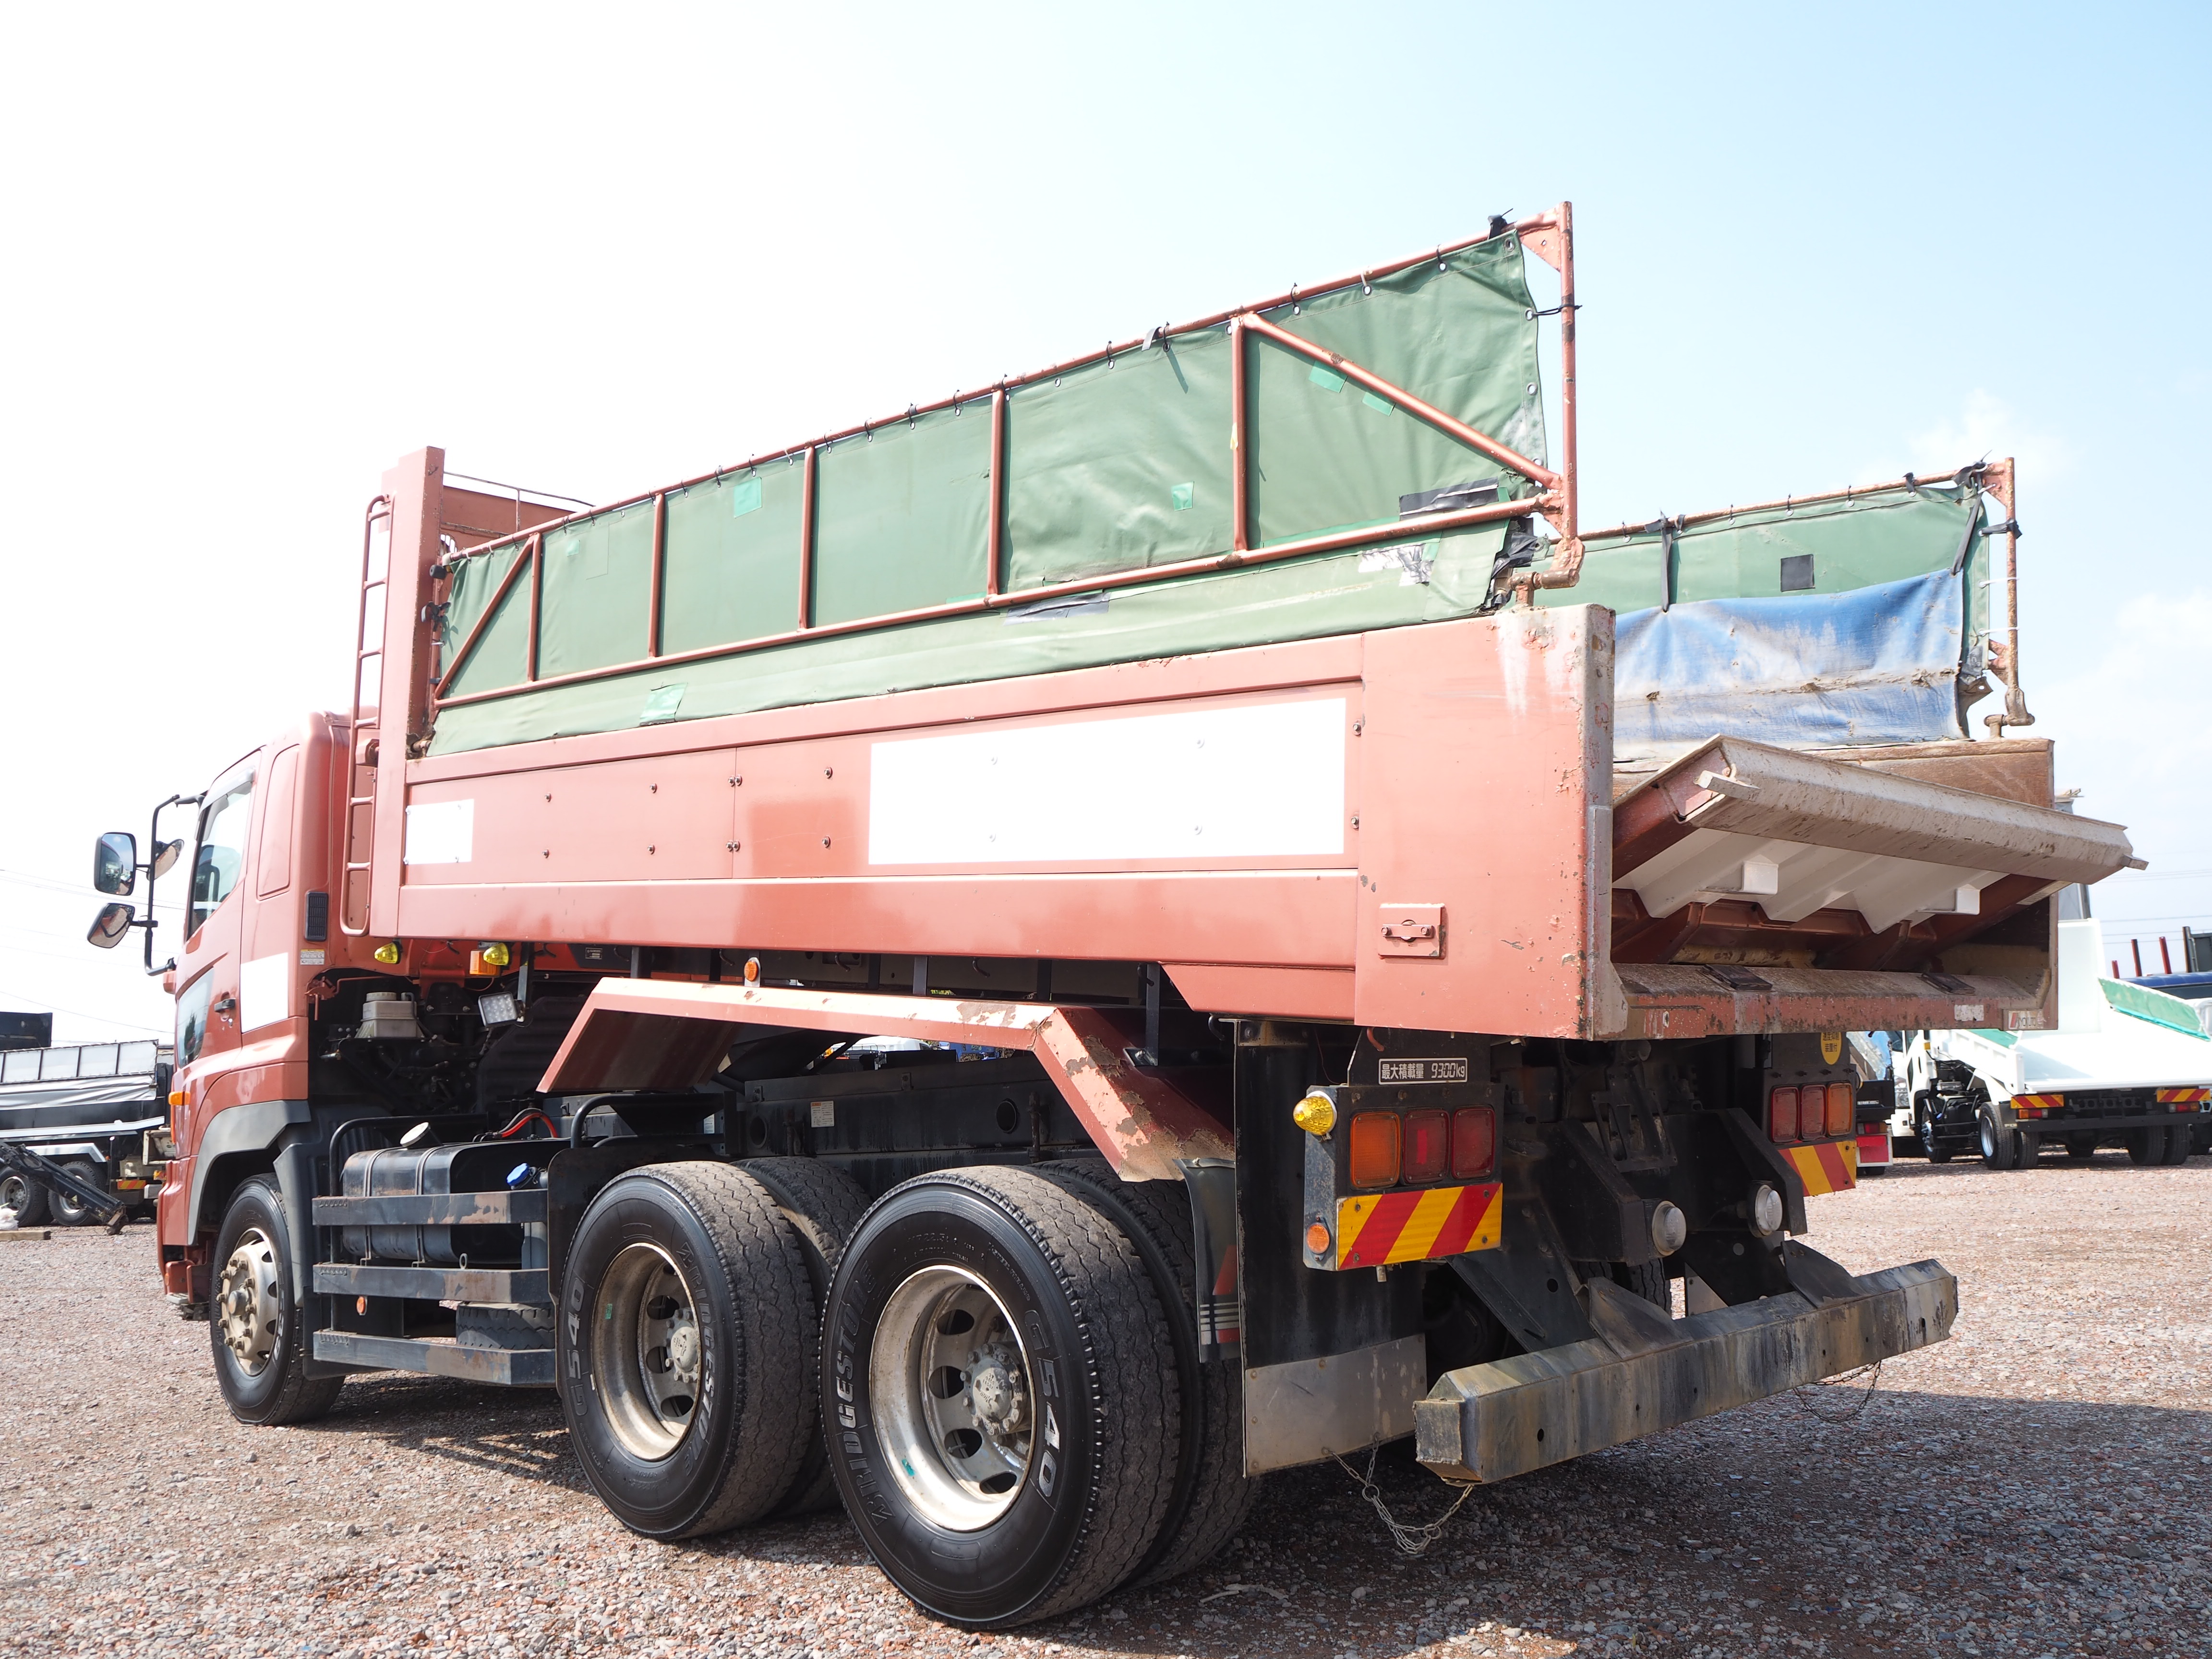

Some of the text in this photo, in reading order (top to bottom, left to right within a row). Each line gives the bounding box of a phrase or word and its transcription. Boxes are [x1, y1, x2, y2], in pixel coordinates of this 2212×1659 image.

[1381, 1063, 1424, 1080] 最大積載量
[676, 1242, 715, 1477] BRIDGESTONE
[836, 1260, 896, 1527] BRIDGESTONE
[1024, 1310, 1060, 1498] G540
